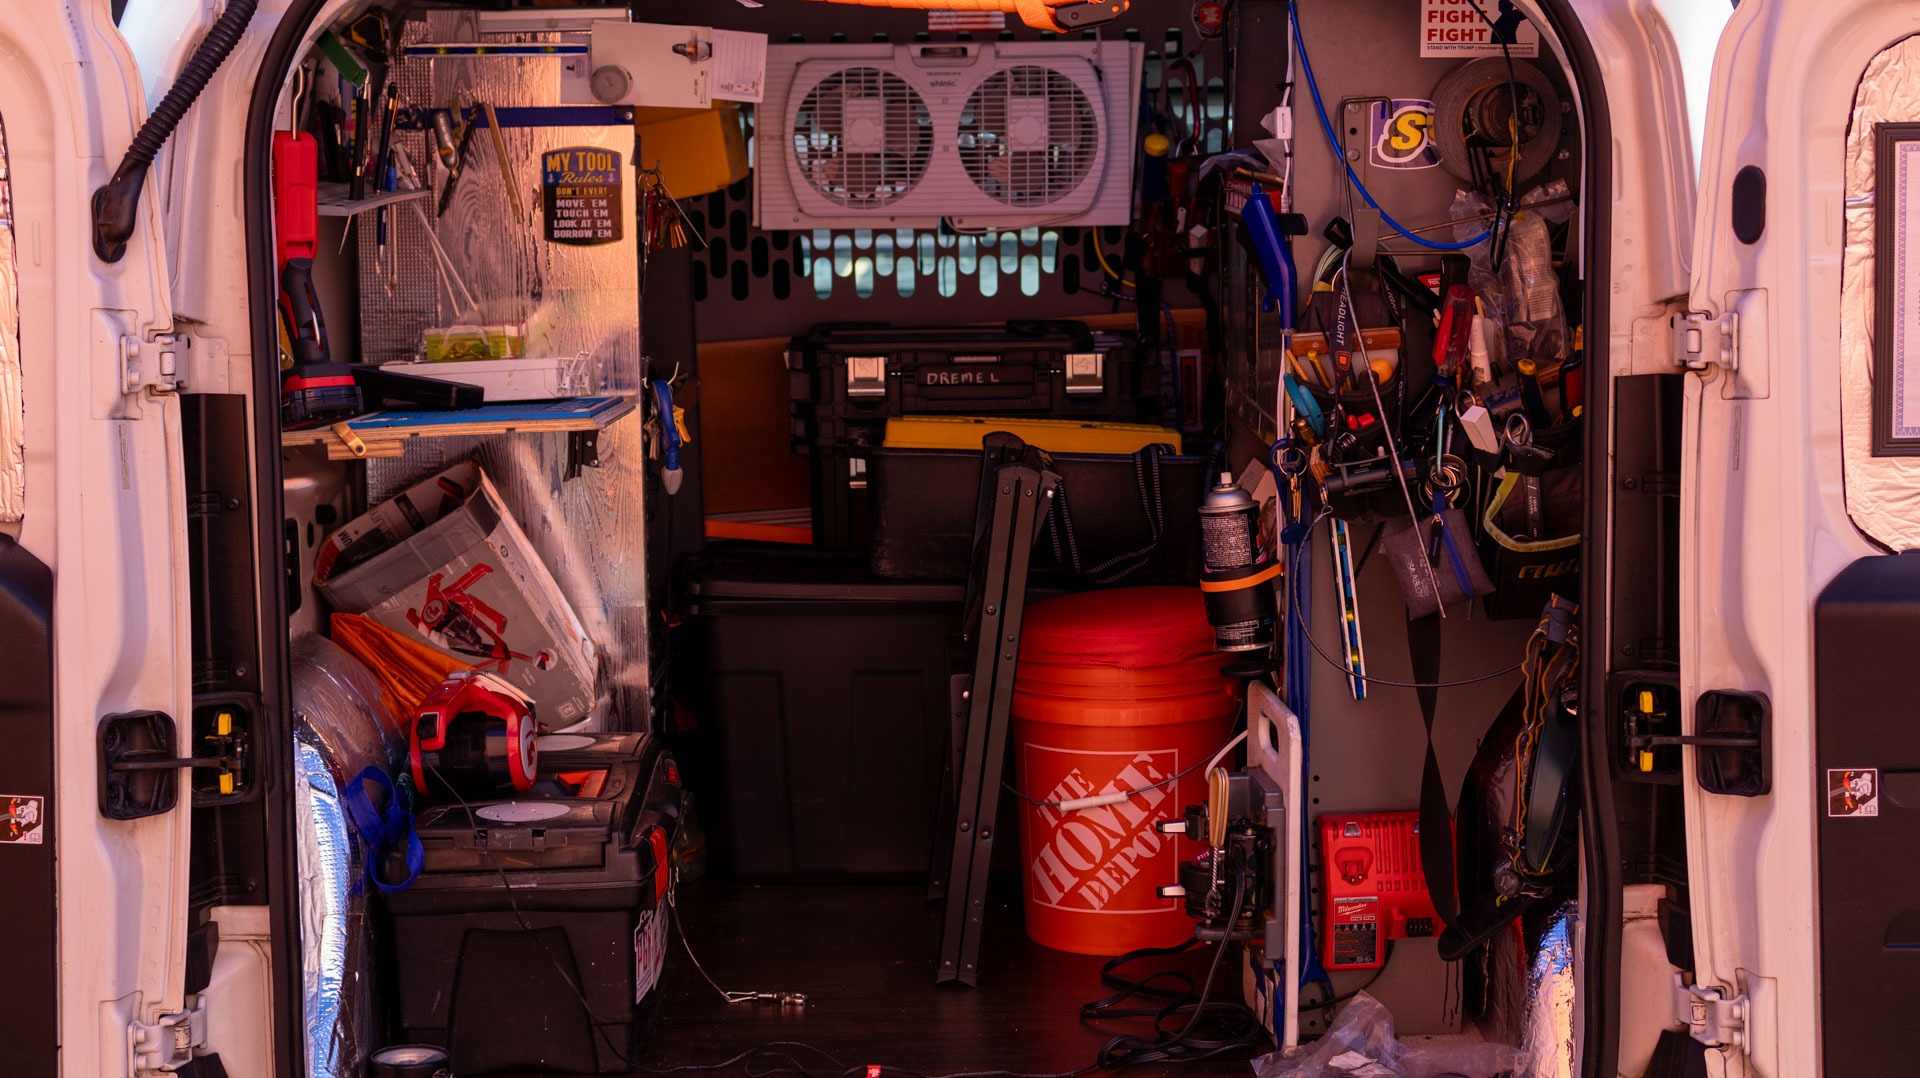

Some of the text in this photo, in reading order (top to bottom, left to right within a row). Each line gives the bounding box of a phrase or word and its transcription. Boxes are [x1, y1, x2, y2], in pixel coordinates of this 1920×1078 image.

[1428, 10, 1488, 23] FIGHT
[1427, 28, 1487, 42] FIGHT
[546, 152, 616, 172] MY TOOL
[559, 171, 604, 183] Rules
[555, 186, 607, 196] DON'T EVER!
[556, 199, 585, 208] MOVE
[555, 209, 589, 218] TOUCH
[554, 219, 577, 228] LOOK
[580, 219, 592, 228] AT
[553, 229, 593, 238] BORROW
[1336, 287, 1348, 347] HEADLIGHT
[926, 371, 1000, 385] DREMEL
[1037, 767, 1096, 829] THE
[1031, 753, 1178, 906] HOME
